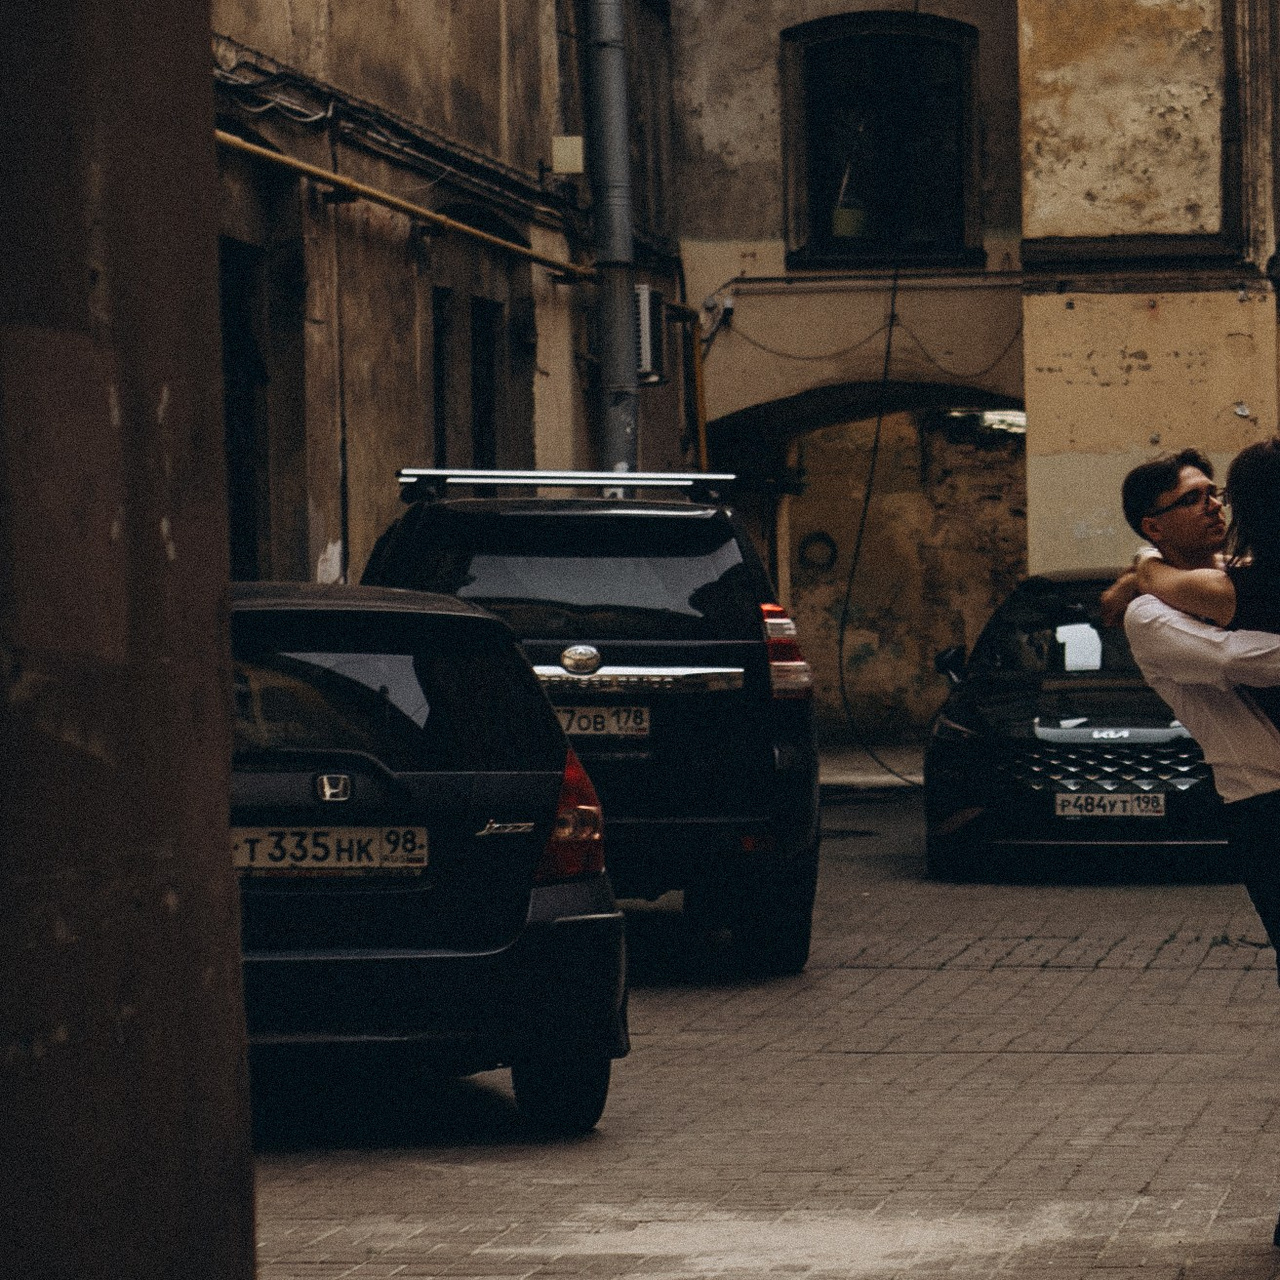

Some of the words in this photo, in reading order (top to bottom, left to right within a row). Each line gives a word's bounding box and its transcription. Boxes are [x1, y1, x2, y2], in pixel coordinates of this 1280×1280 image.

[611, 708, 644, 726] 178
[1134, 795, 1160, 809] 198
[385, 829, 416, 854] 98
